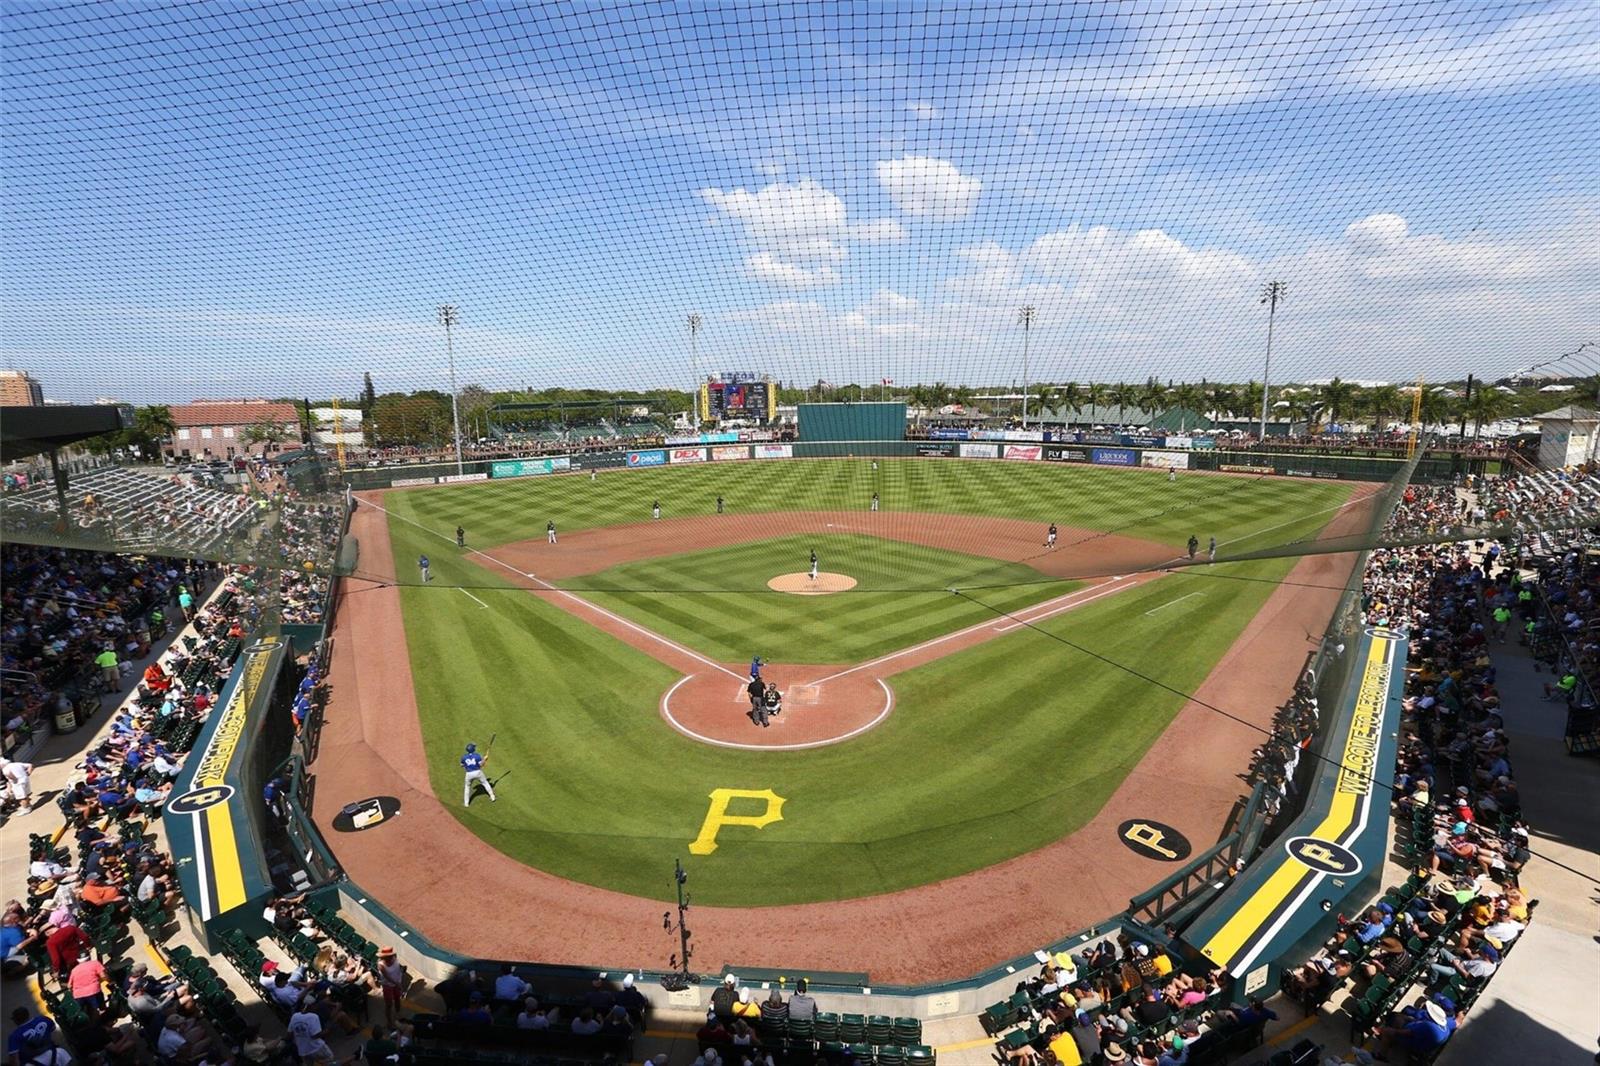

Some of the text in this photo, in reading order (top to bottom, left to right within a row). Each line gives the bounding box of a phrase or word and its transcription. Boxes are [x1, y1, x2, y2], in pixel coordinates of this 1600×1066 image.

[641, 454, 661, 463] pepsi
[674, 450, 699, 459] DEX
[1354, 714, 1381, 729] TO
[195, 743, 232, 784] PARK
[1338, 729, 1379, 796] WELCOME
[688, 788, 787, 855] P
[1124, 823, 1178, 859] P
[1299, 843, 1345, 870] P
